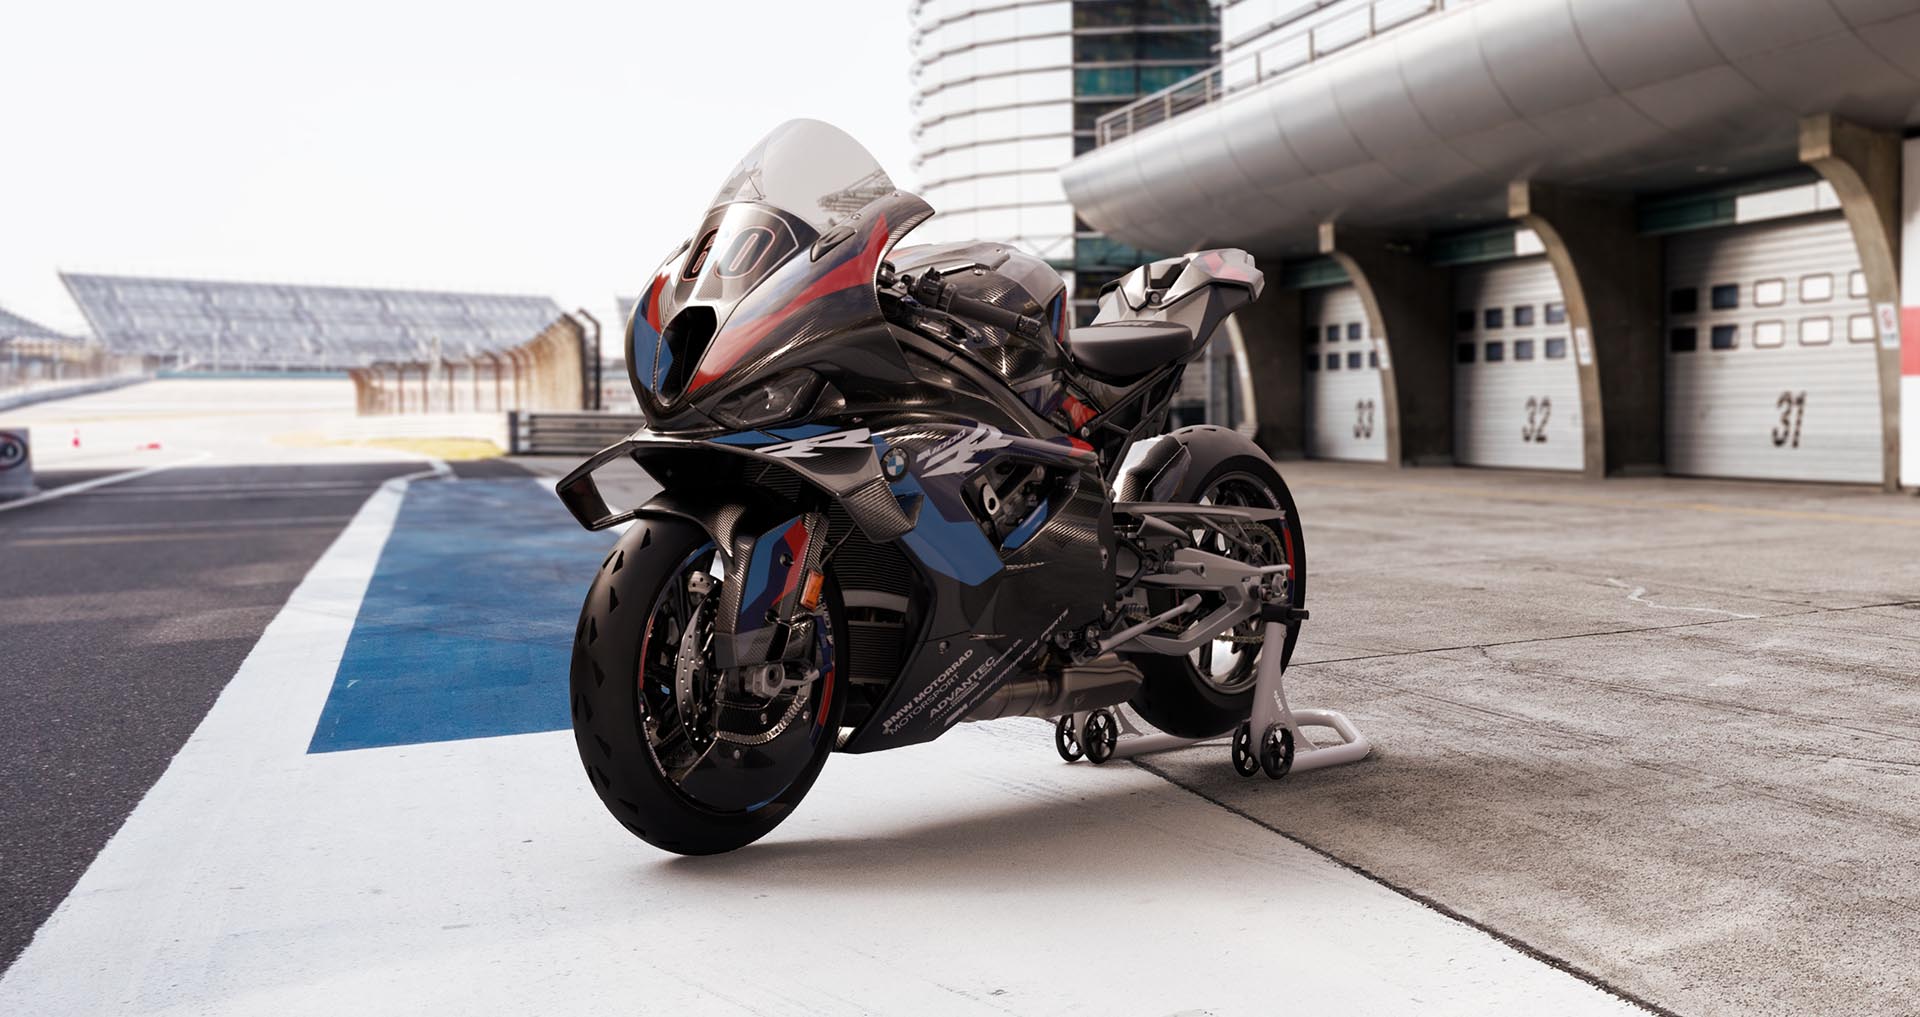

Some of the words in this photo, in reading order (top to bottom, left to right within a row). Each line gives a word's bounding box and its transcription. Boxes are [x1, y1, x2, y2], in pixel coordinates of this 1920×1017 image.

[1353, 400, 1375, 439] 33
[1522, 396, 1551, 443] 32
[1772, 390, 1807, 448] 31
[882, 702, 913, 728] BMW
[912, 648, 974, 704] MOTORRAD
[889, 671, 960, 735] MOTORSPORT
[929, 656, 996, 718] ADVANTEC
